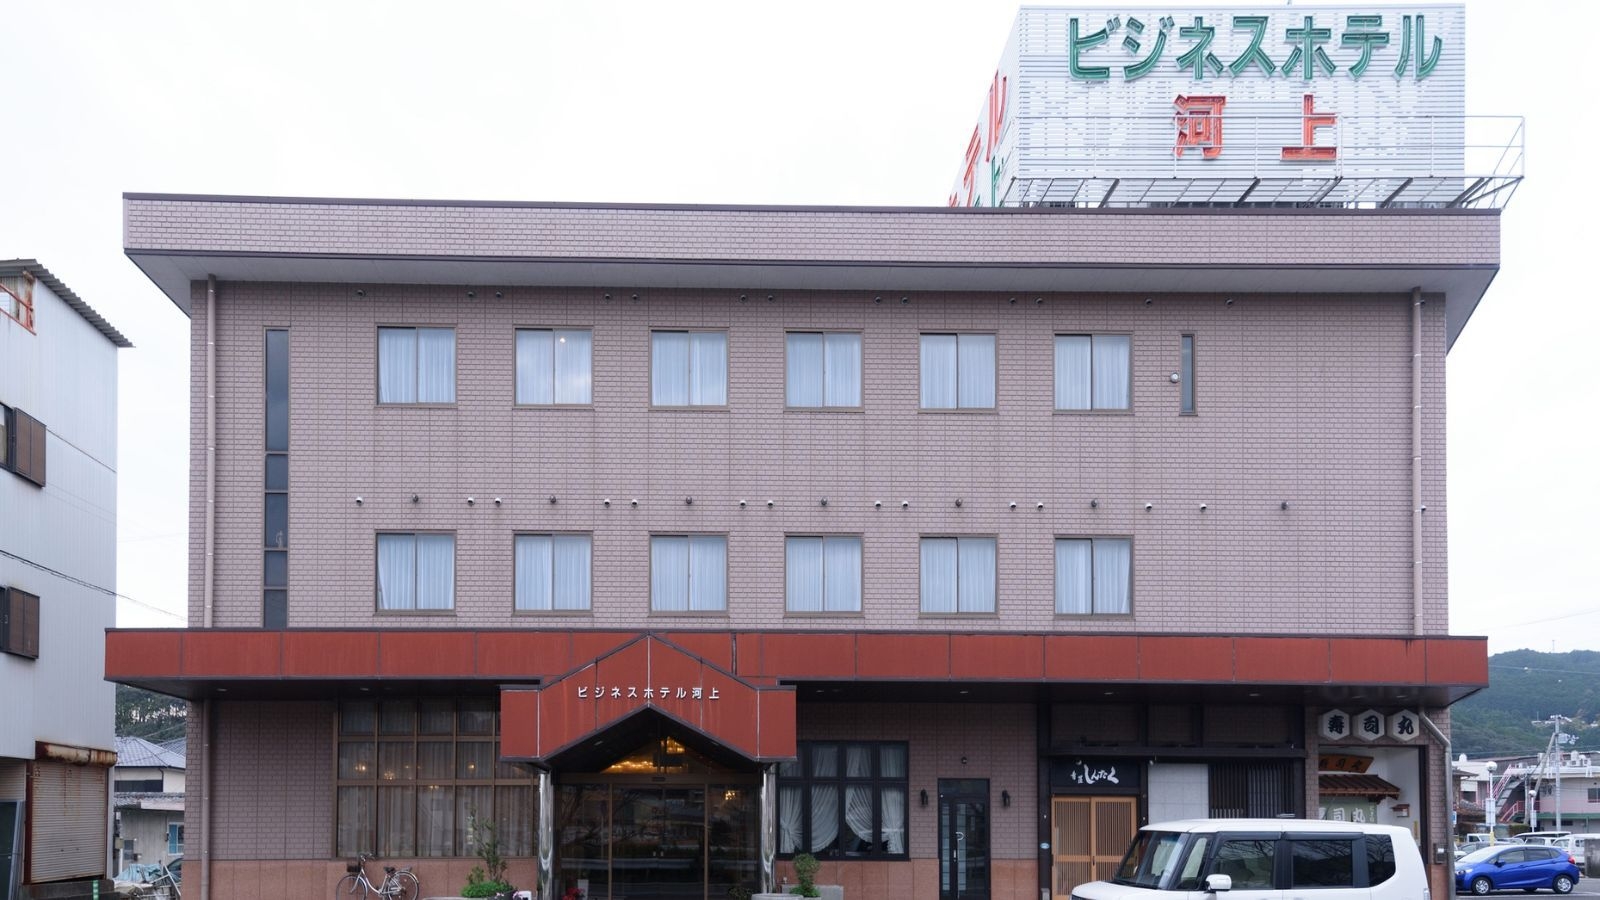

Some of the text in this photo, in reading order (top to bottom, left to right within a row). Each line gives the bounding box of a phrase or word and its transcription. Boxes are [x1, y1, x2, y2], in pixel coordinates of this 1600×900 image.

[1069, 14, 1442, 80] ビジネスホテル
[1173, 94, 1337, 161] 河上
[577, 686, 720, 700] ビジネスホテル河上
[1328, 715, 1414, 735] 寿司丸
